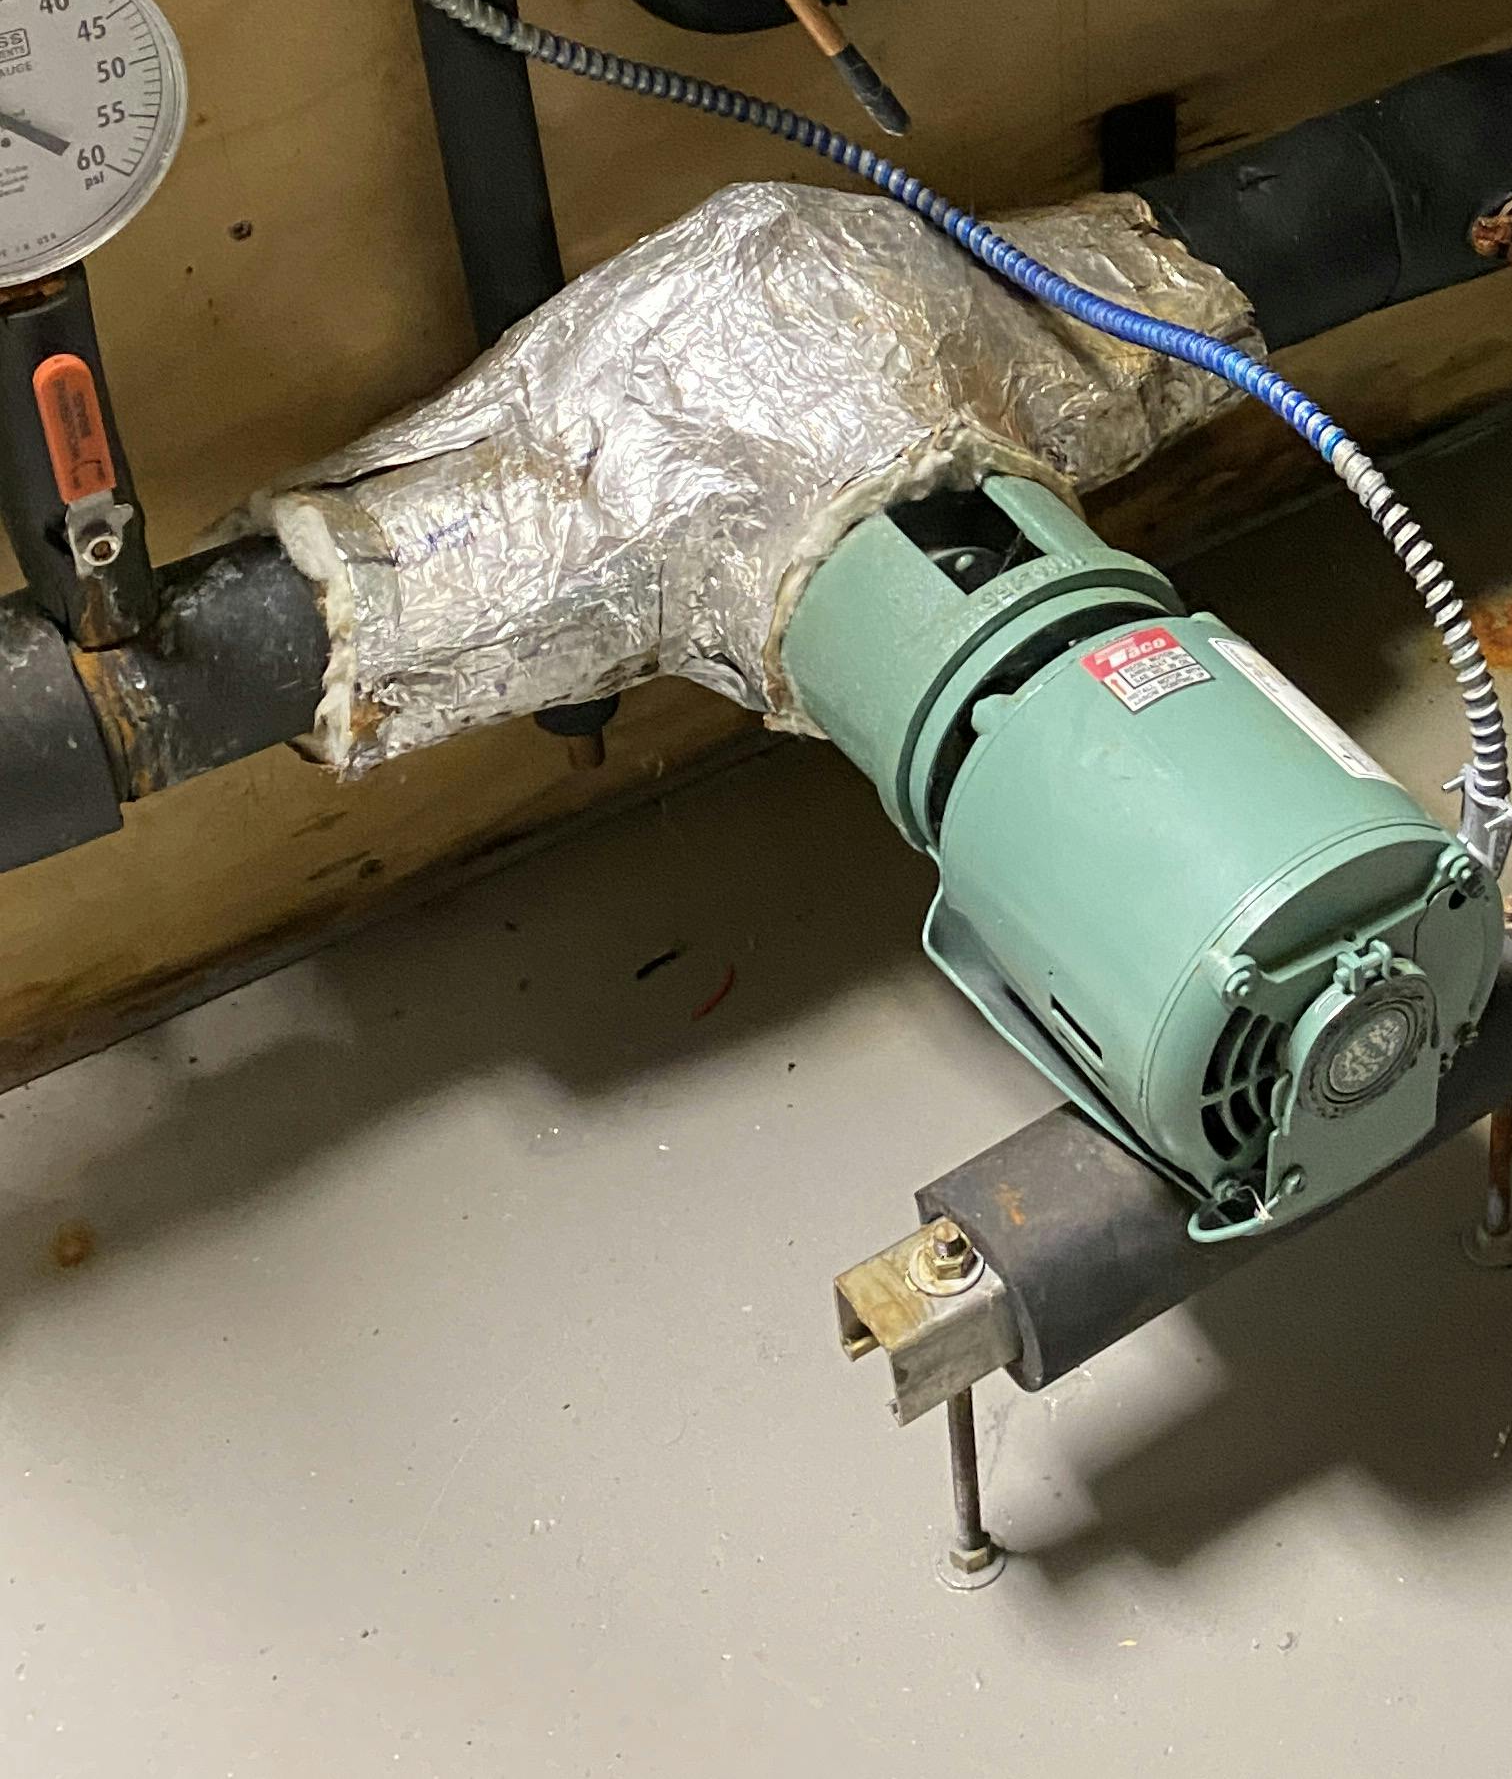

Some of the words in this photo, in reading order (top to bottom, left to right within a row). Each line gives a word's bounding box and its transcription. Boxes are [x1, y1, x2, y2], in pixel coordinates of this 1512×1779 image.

[78, 15, 107, 42] 45
[97, 56, 126, 83] 50
[97, 100, 126, 129] 55
[76, 144, 106, 172] 60
[84, 171, 105, 190] psi
